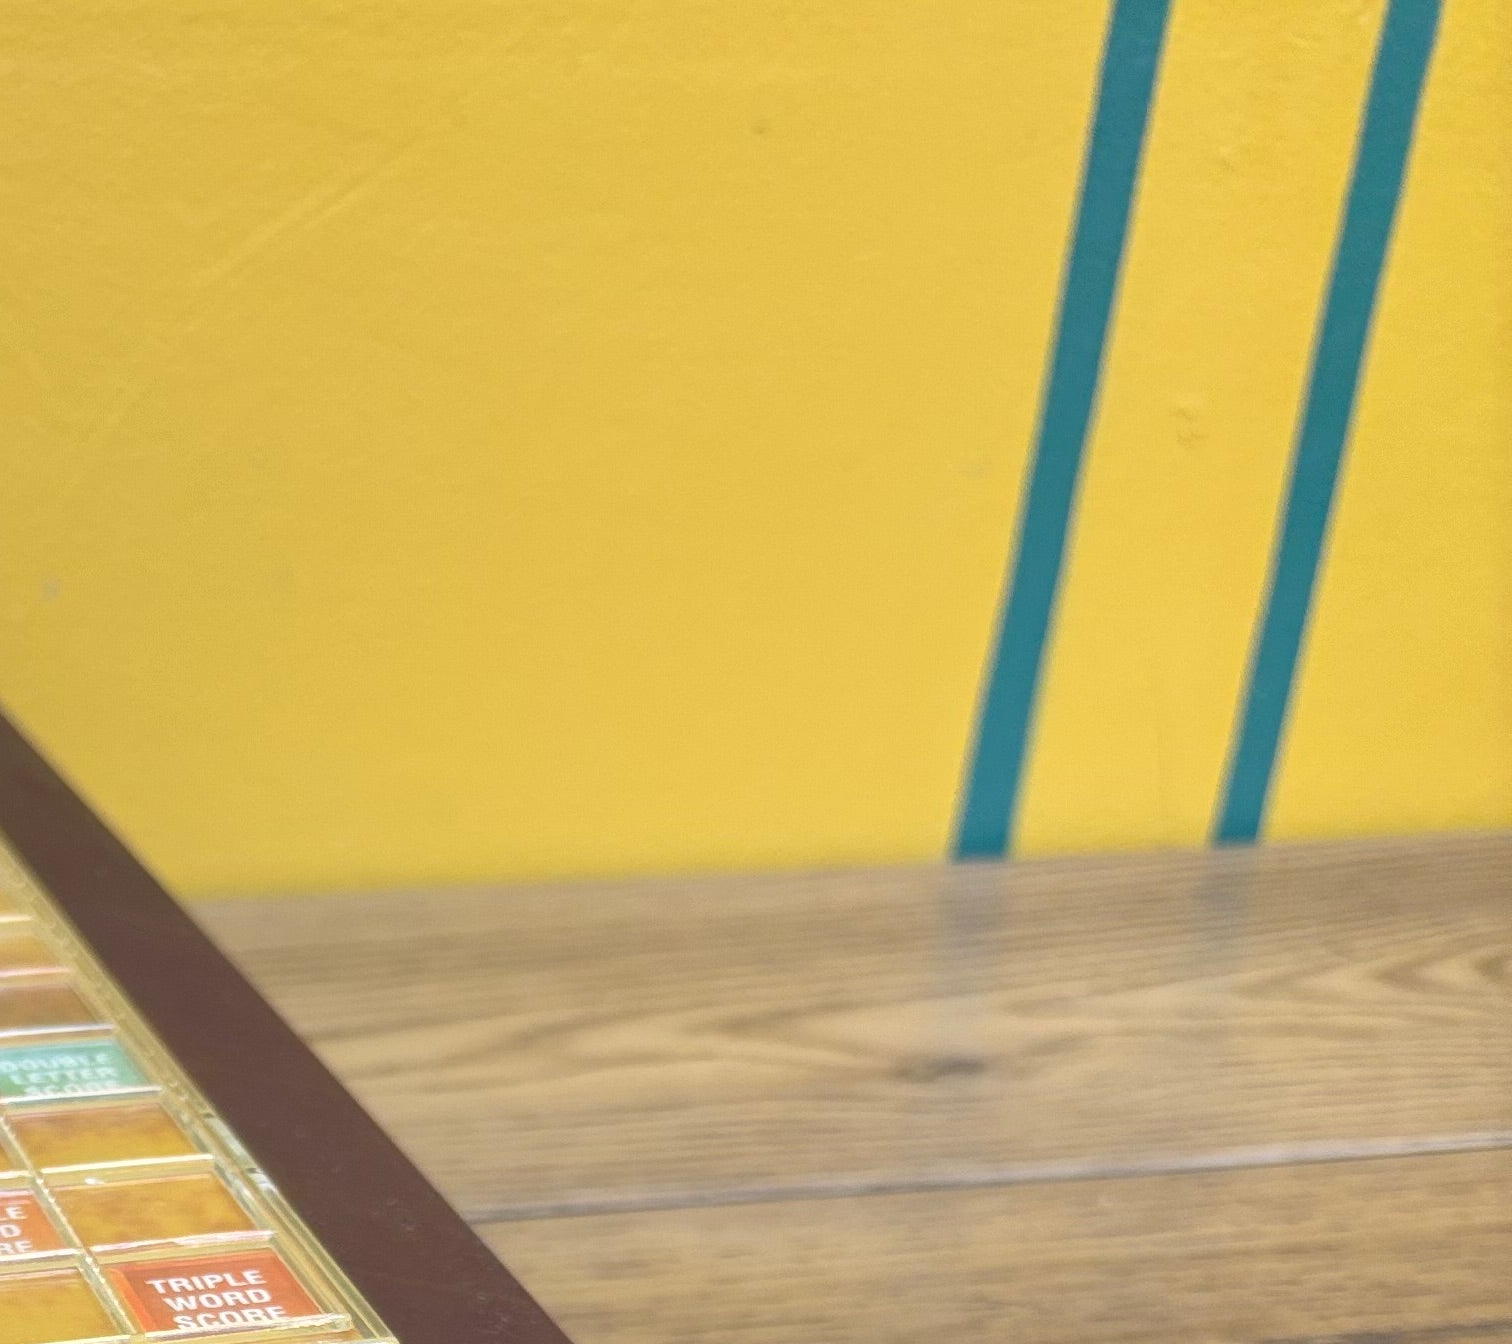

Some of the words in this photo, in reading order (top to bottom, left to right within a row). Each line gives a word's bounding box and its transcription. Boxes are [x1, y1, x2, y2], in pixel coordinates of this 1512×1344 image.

[145, 1269, 268, 1295] TRIPLE
[162, 1288, 272, 1313] WORD
[172, 1305, 288, 1331] SCORE
